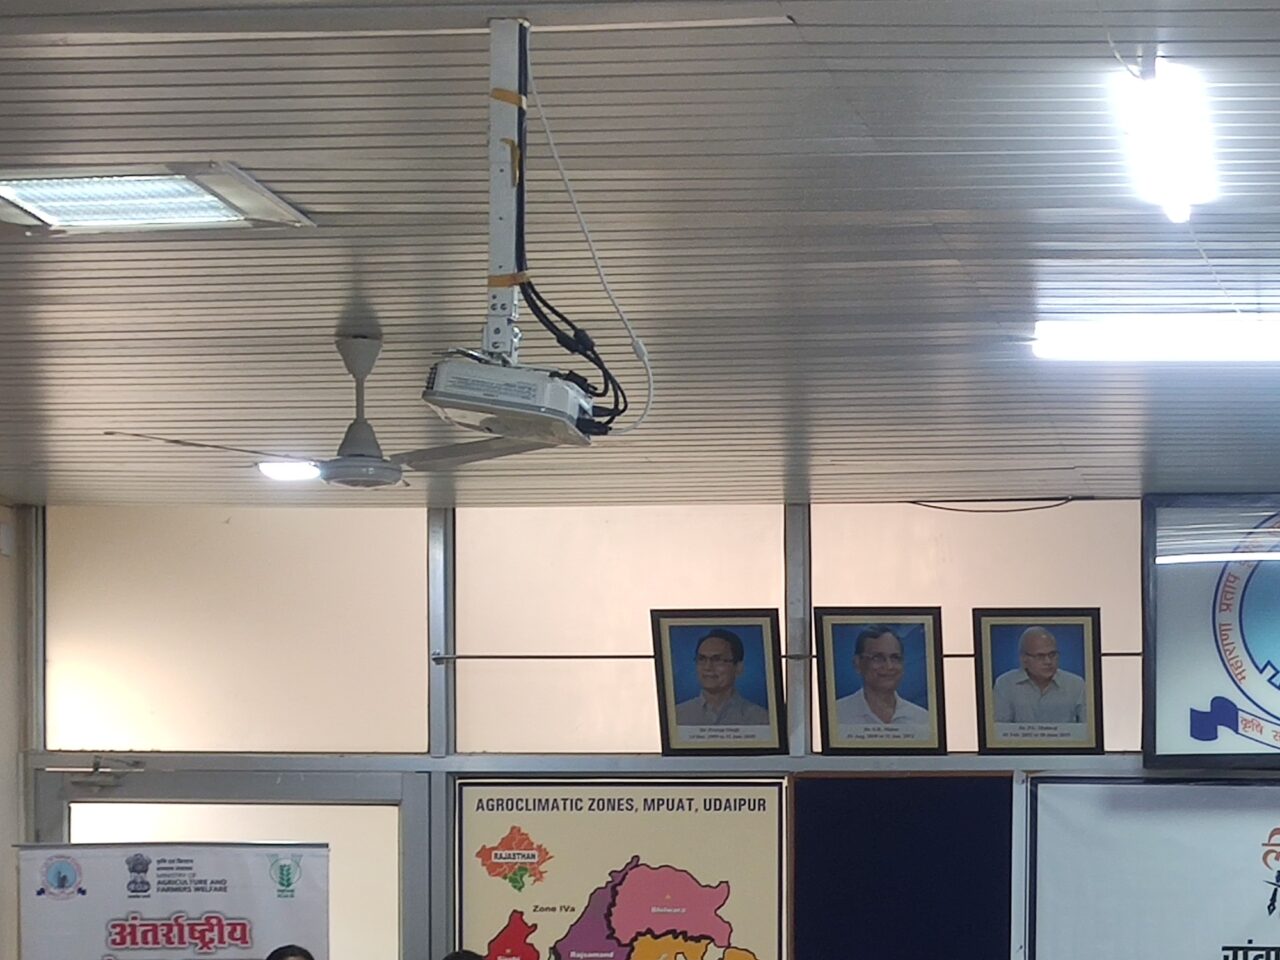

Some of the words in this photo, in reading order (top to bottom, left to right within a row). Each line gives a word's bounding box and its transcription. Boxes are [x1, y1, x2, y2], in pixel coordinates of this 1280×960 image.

[476, 798, 584, 812] AGROCLIMATIC
[588, 798, 639, 813] ZONES,
[643, 798, 699, 813] MPUAT,
[703, 798, 767, 812] UDAIPUR
[494, 852, 536, 861] RAJASTHAN
[533, 905, 556, 913] Zone
[560, 905, 575, 913] IVa
